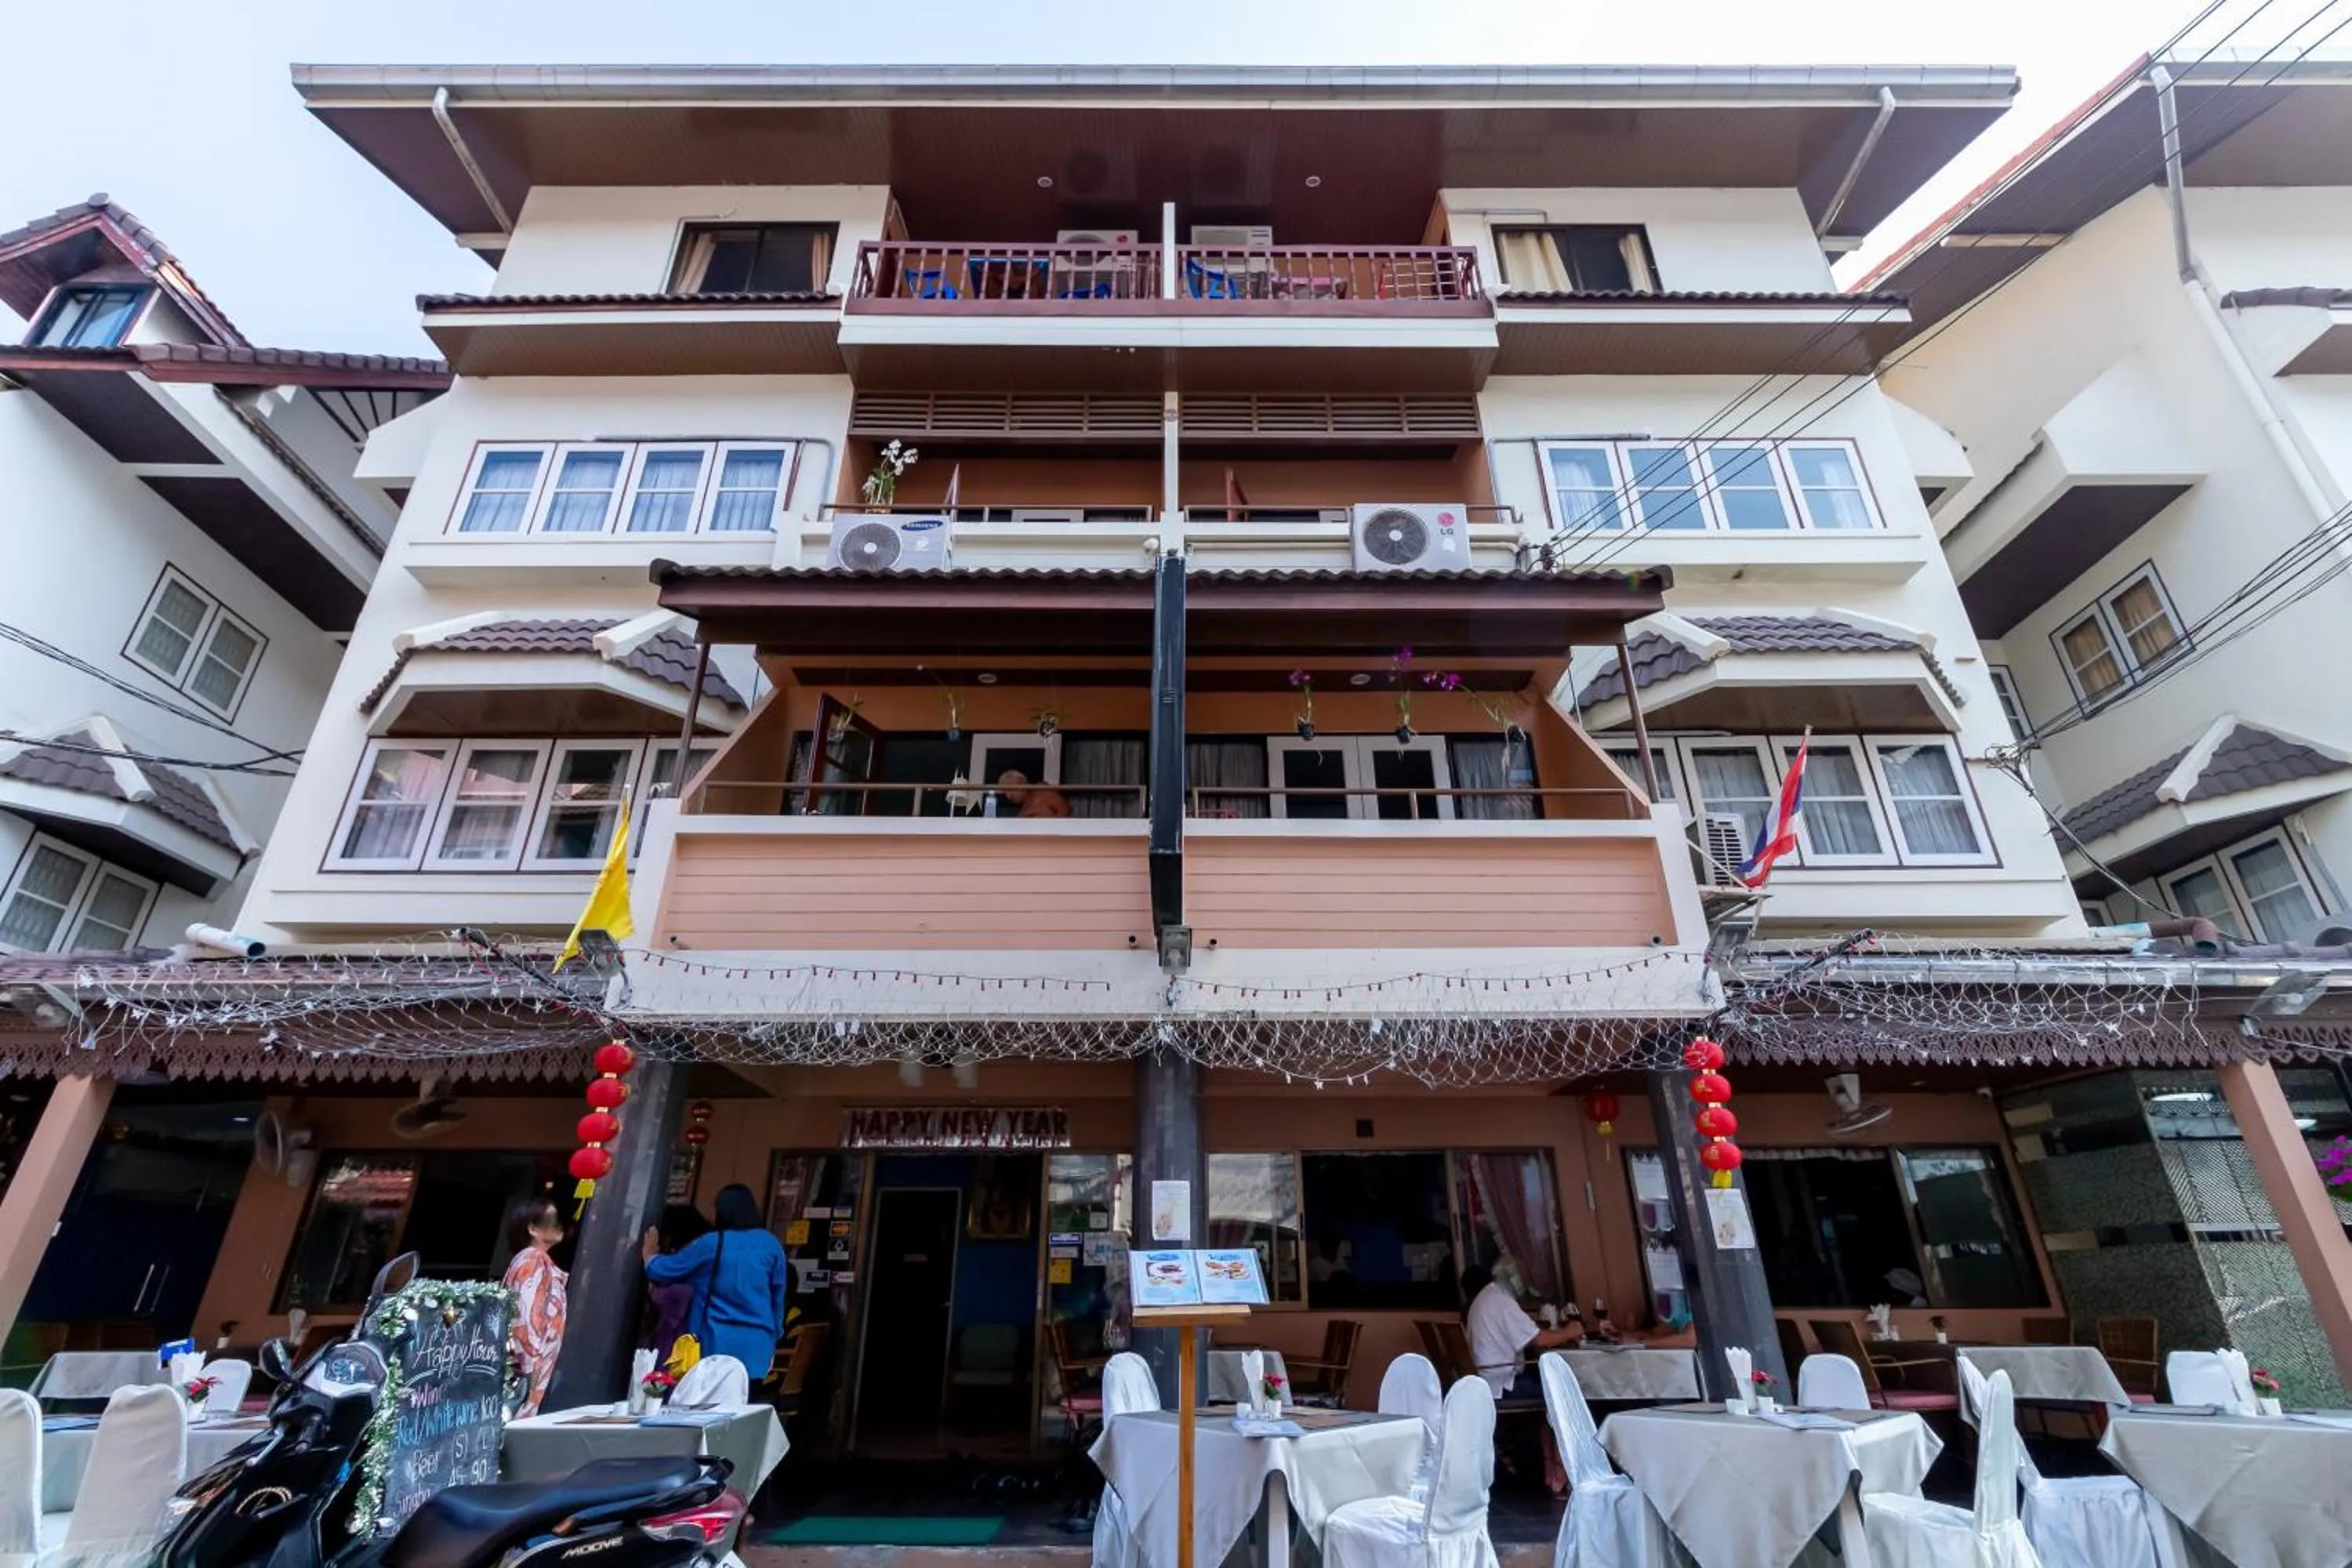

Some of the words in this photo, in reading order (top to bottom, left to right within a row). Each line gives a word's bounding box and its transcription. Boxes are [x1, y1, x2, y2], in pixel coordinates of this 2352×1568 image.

[849, 1110, 931, 1136] HAPPY
[942, 1110, 997, 1136] NEW
[1007, 1110, 1067, 1136] YEAR
[412, 1330, 470, 1380] Happy
[412, 1449, 439, 1483] Beer
[561, 1536, 623, 1559] MOOVE
